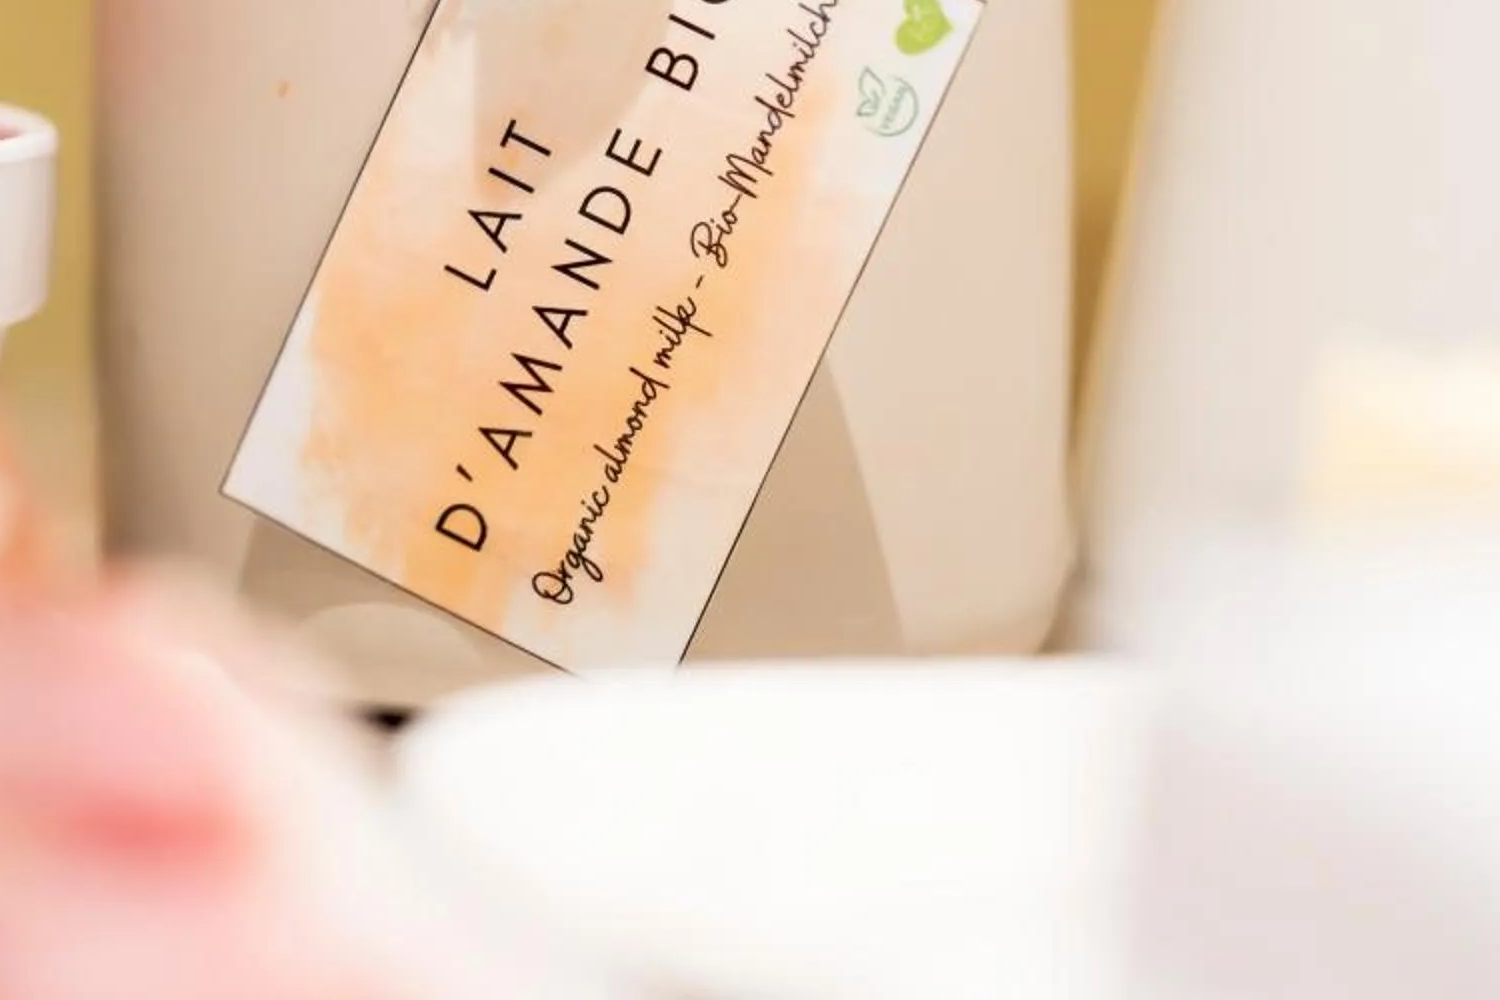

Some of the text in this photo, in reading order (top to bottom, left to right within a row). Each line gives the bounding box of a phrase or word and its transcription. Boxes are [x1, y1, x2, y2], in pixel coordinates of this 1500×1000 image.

[434, 128, 663, 553] D'AMANDE
[443, 119, 552, 292] LAIT
[531, 485, 610, 605] Organic
[593, 366, 670, 484] almond
[652, 296, 713, 369] milk
